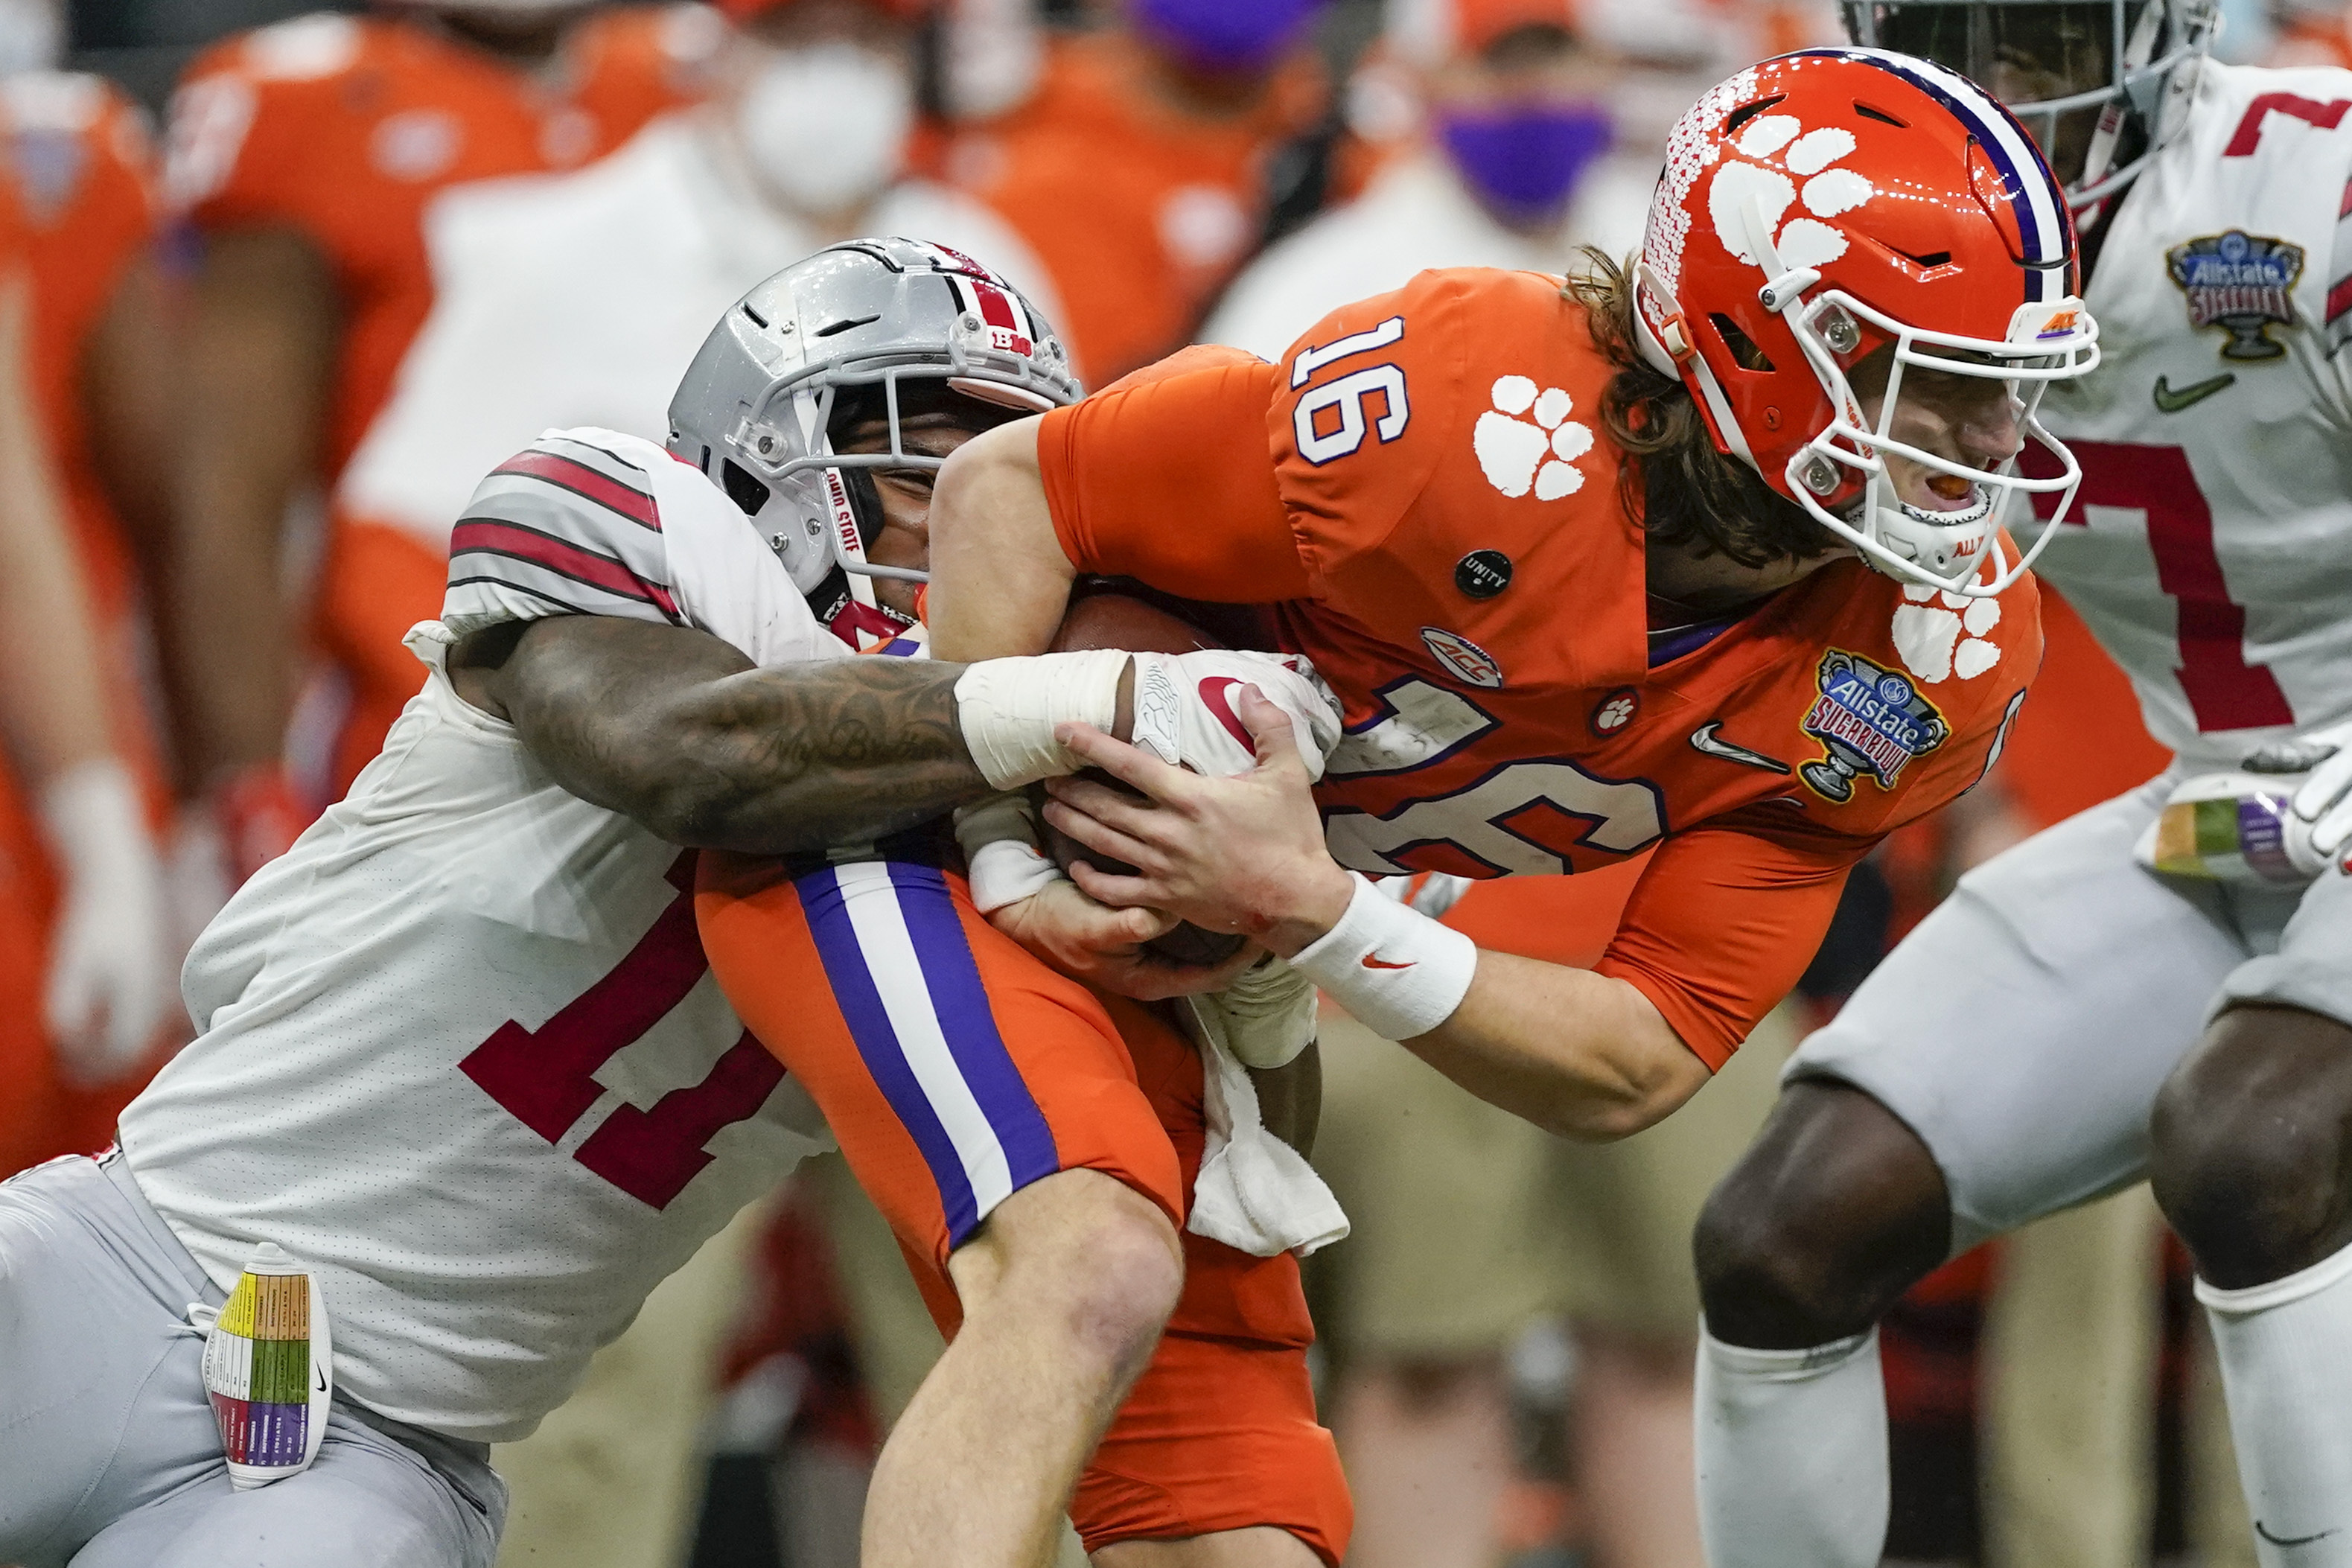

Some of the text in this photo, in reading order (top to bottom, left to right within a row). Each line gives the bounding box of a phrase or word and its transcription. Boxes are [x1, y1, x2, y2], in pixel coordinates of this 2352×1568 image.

[1290, 315, 1410, 468] 16
[838, 511, 859, 552] STATE
[1465, 557, 1506, 587] UNITY
[2018, 436, 2296, 734] 7
[1430, 639, 1497, 681] ACC
[1830, 678, 1919, 745] Allstate
[1325, 674, 1668, 880] 16
